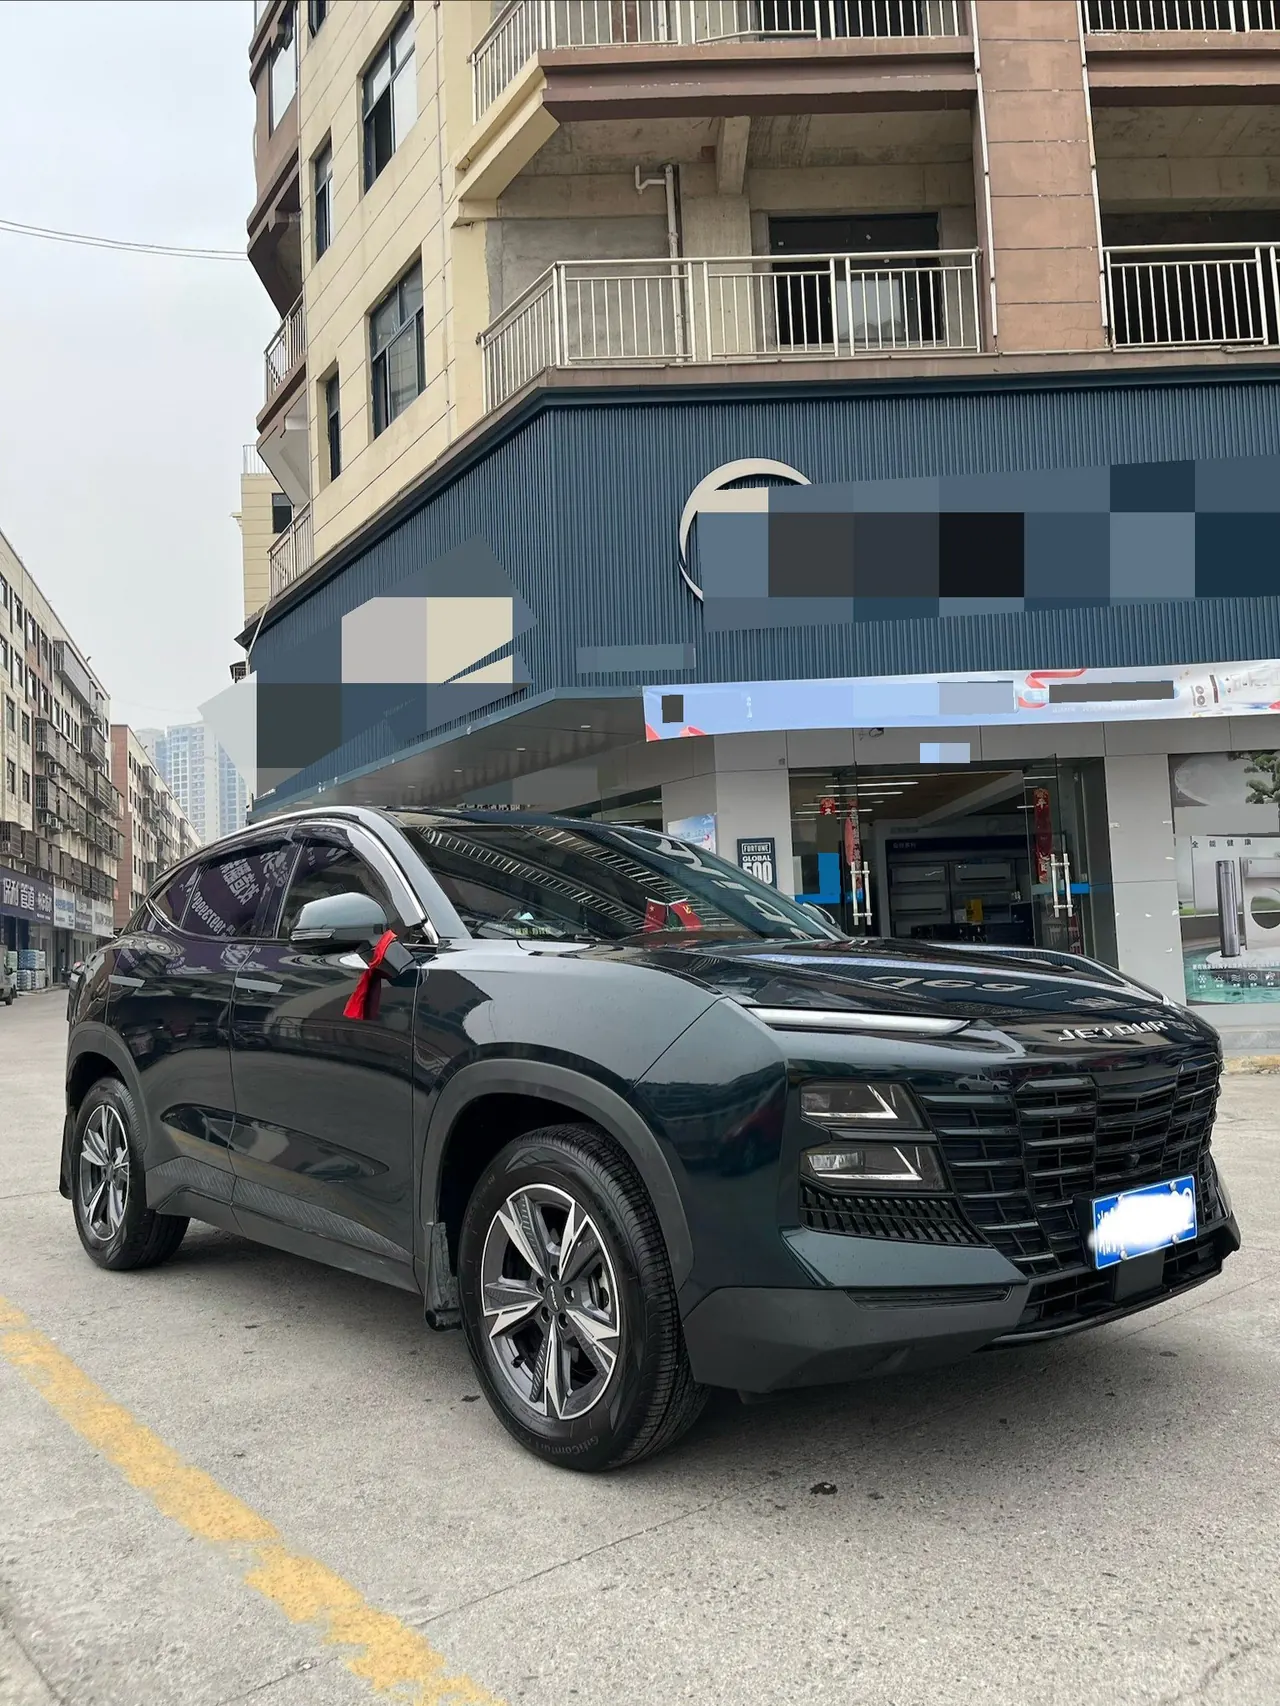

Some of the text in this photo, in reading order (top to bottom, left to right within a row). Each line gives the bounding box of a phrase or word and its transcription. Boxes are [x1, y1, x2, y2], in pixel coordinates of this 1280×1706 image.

[743, 844, 769, 853] FORTUNE
[1191, 838, 1252, 848] 全能健康
[742, 861, 773, 885] 500
[1058, 1020, 1169, 1042] JETOUR
